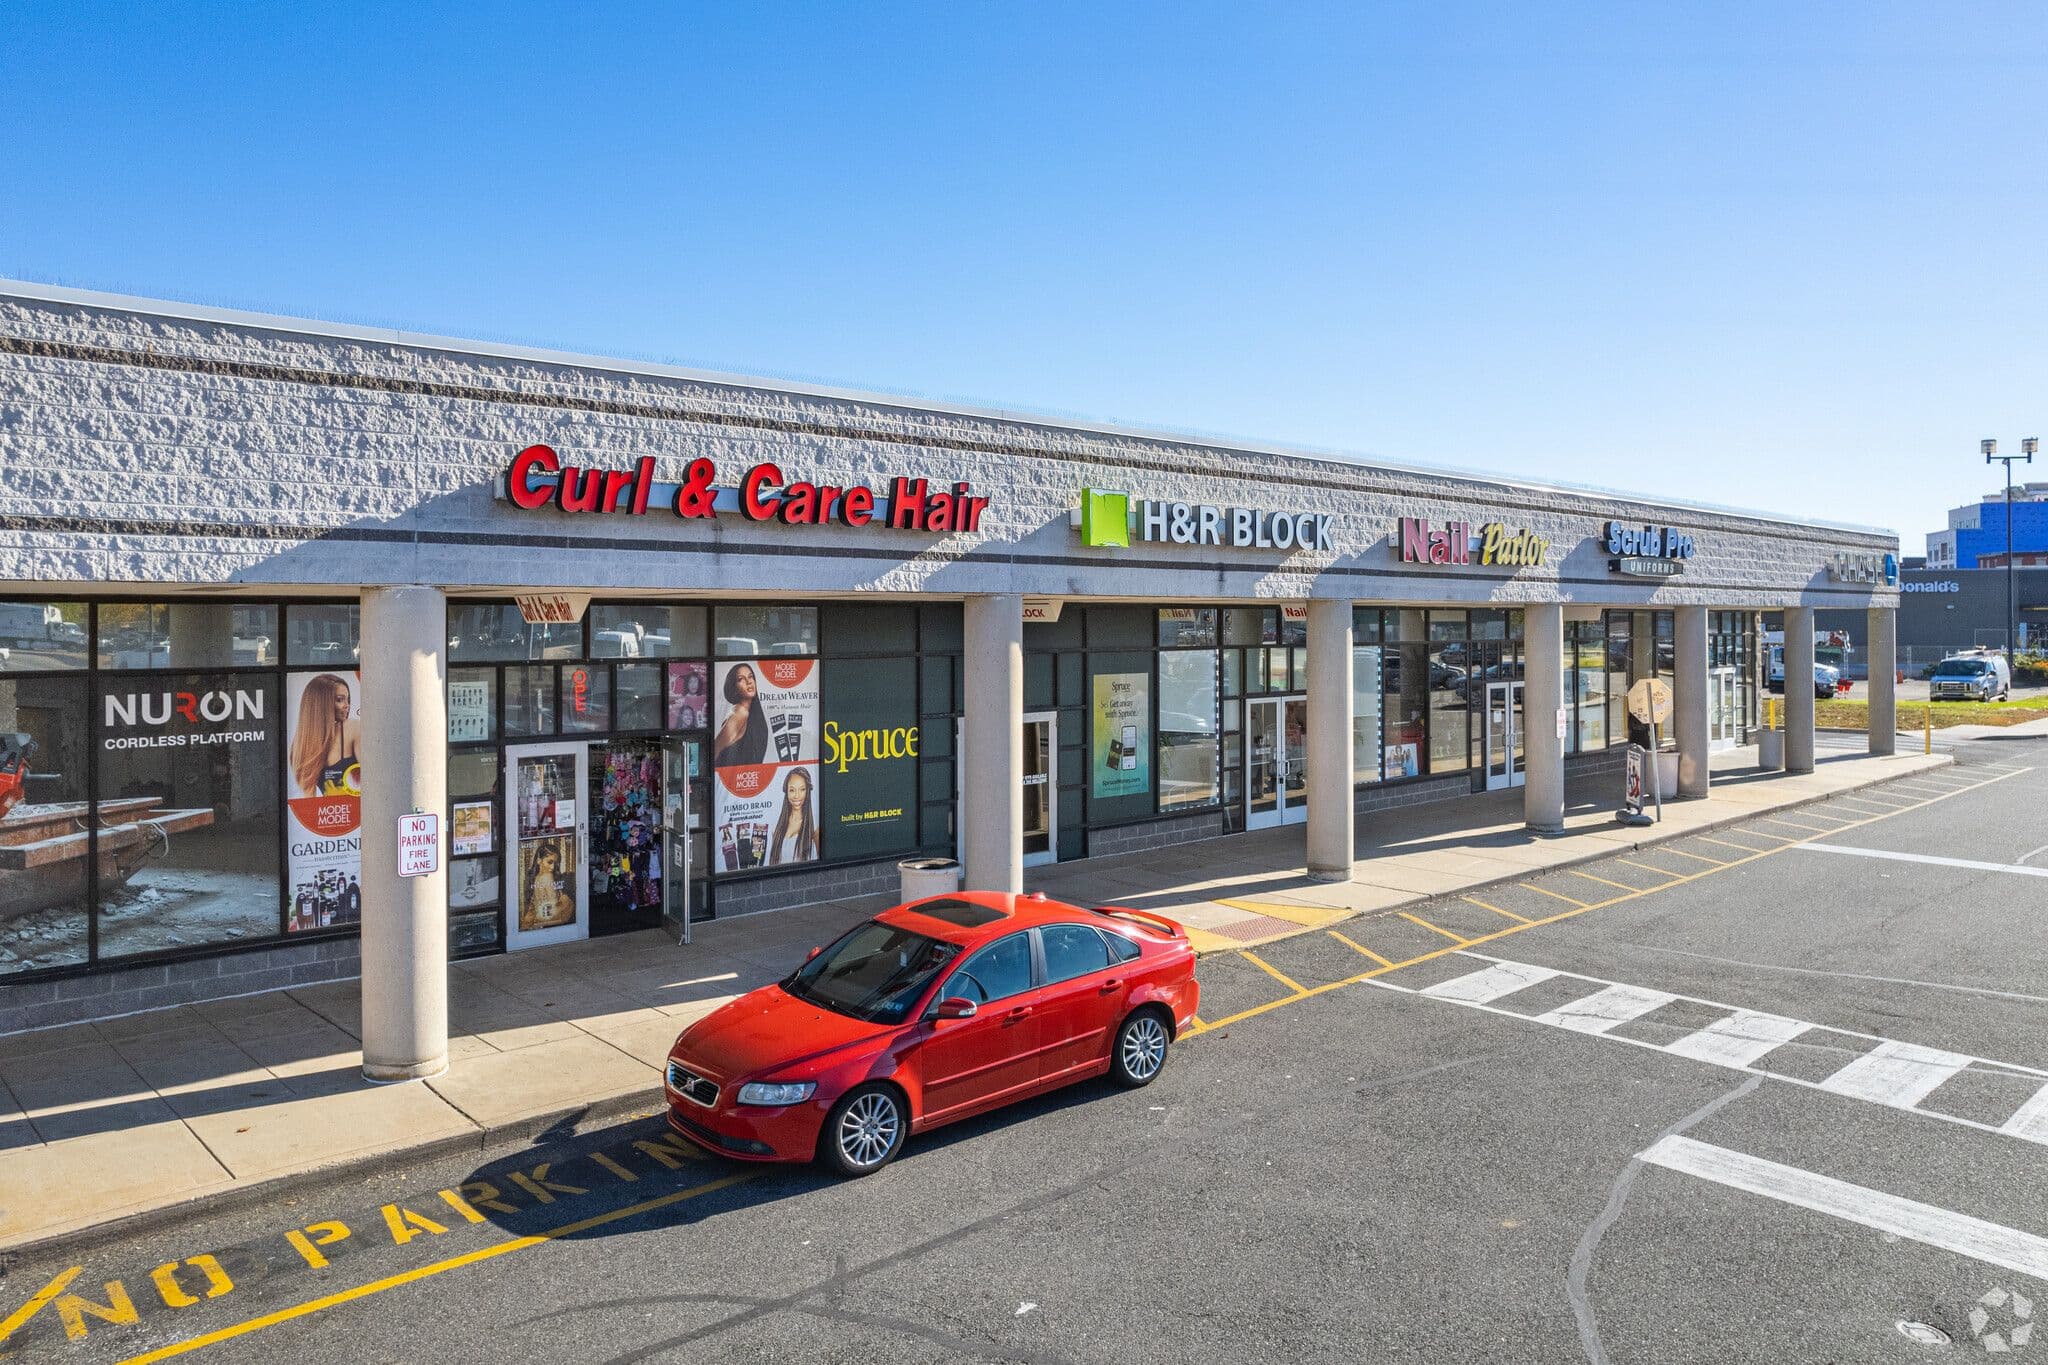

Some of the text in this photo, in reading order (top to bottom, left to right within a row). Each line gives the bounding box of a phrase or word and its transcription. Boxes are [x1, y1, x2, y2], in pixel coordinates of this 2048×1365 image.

[507, 444, 989, 532] Curl & Care Hair
[1142, 500, 1335, 551] H&R BLOCK
[1402, 516, 1549, 567] Nail Parlor
[1606, 520, 1695, 559] Scrub Pro
[1629, 560, 1675, 575] UNIFORMS
[774, 662, 797, 672] MODEL
[774, 670, 797, 680] MODEL
[1111, 681, 1131, 693] Spruce
[105, 689, 264, 727] NURON
[104, 730, 265, 750] CORDLESS PLATFORM
[824, 720, 918, 774] Spruce
[736, 771, 759, 780] MODEL
[736, 779, 759, 789] MODEL
[318, 804, 351, 816] MODEL
[723, 802, 750, 814] JUMBO
[750, 800, 773, 810] BRAID
[880, 808, 903, 818] BLOCK
[318, 814, 351, 825] MODEL
[411, 820, 426, 832] NO
[401, 833, 436, 848] PARKING
[409, 849, 429, 859] FIRE
[406, 860, 432, 871] LANE
[51, 1132, 702, 1341] NO PARKIN
